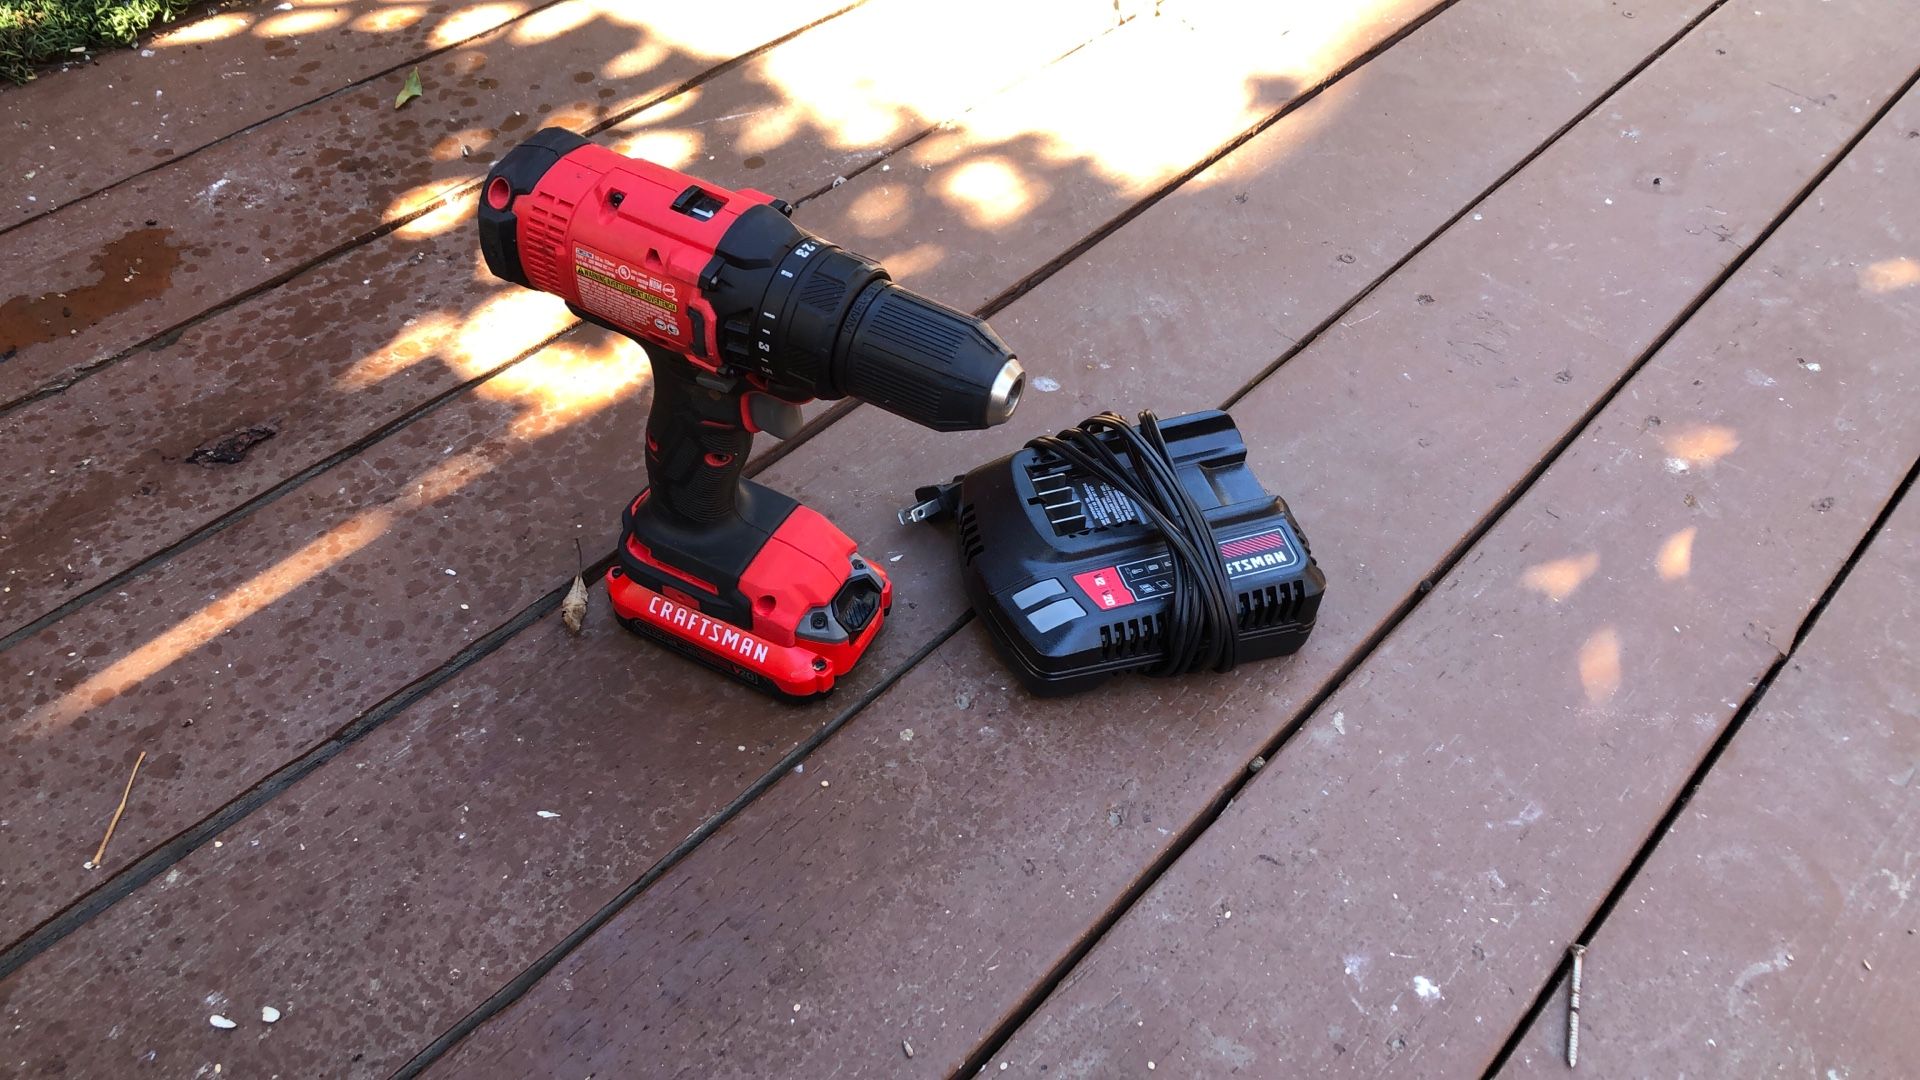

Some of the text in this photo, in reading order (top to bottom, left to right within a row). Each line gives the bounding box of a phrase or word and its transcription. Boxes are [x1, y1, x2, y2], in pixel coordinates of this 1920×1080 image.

[795, 242, 816, 258] 23
[758, 341, 770, 352] 3
[1226, 551, 1287, 575] FTSMAN
[648, 596, 769, 663] CRAFTSMAN
